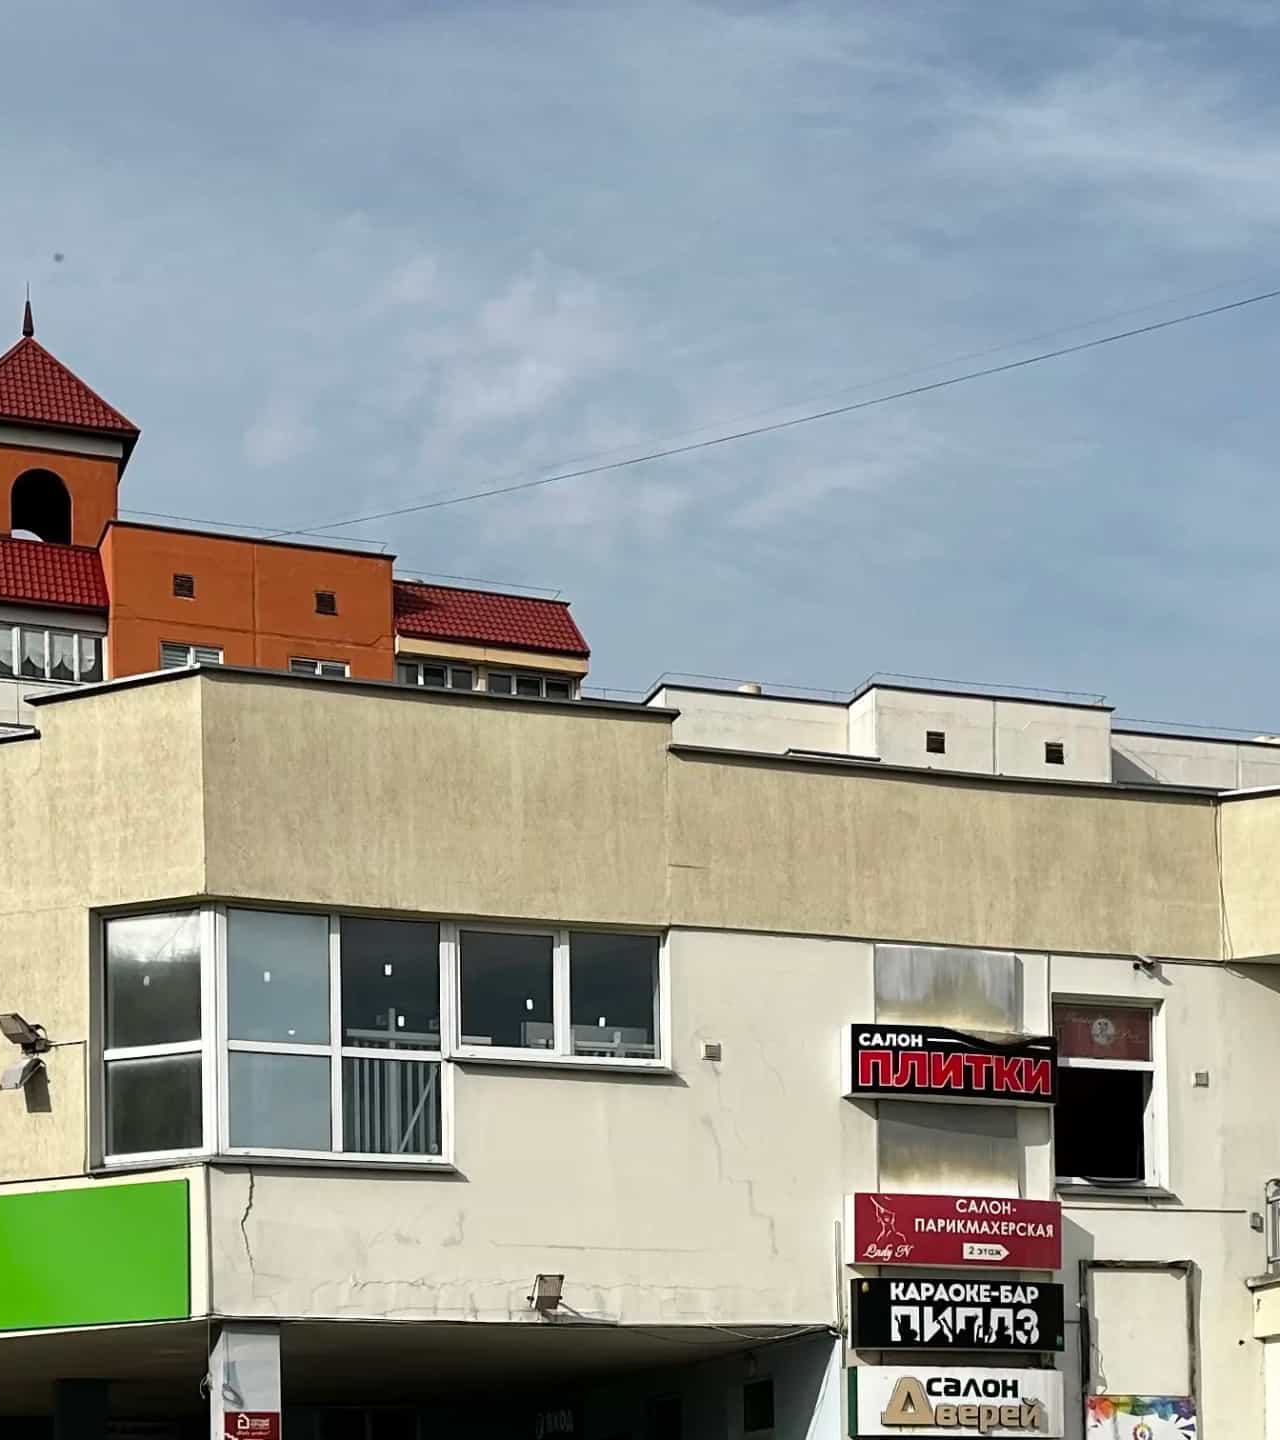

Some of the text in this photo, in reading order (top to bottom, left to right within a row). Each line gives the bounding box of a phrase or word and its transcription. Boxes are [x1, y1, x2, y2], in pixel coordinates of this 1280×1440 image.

[858, 1033, 923, 1048] САЛОН
[858, 1050, 1052, 1095] ПЛИТКИ
[955, 1198, 1018, 1215] САЛОН-
[913, 1217, 1055, 1239] ПАРИКМАХЕРСКАЯ
[968, 1245, 975, 1256] 2
[889, 1281, 1040, 1305] КАРАОКЕ-БАР
[925, 1376, 1019, 1398] салон
[880, 1376, 1041, 1434] Дверей
